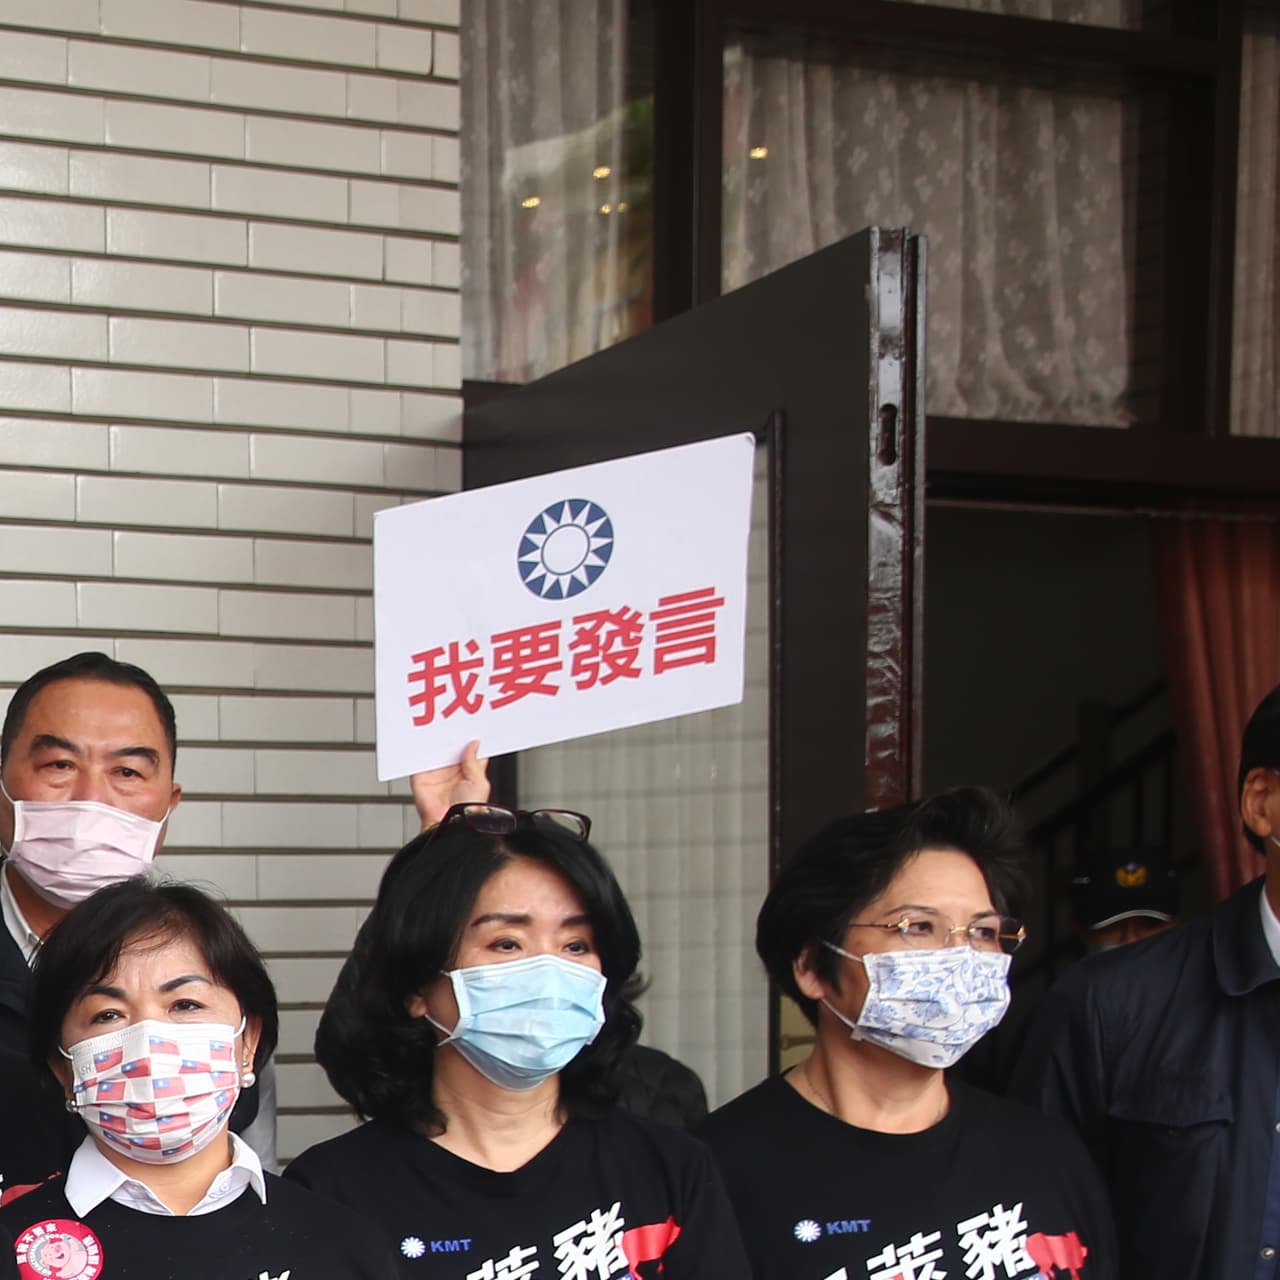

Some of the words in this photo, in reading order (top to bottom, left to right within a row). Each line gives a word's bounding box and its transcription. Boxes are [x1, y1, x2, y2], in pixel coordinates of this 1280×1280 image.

[406, 586, 725, 727] 我要發言
[826, 1219, 871, 1235] KMT
[430, 1238, 472, 1253] KMT
